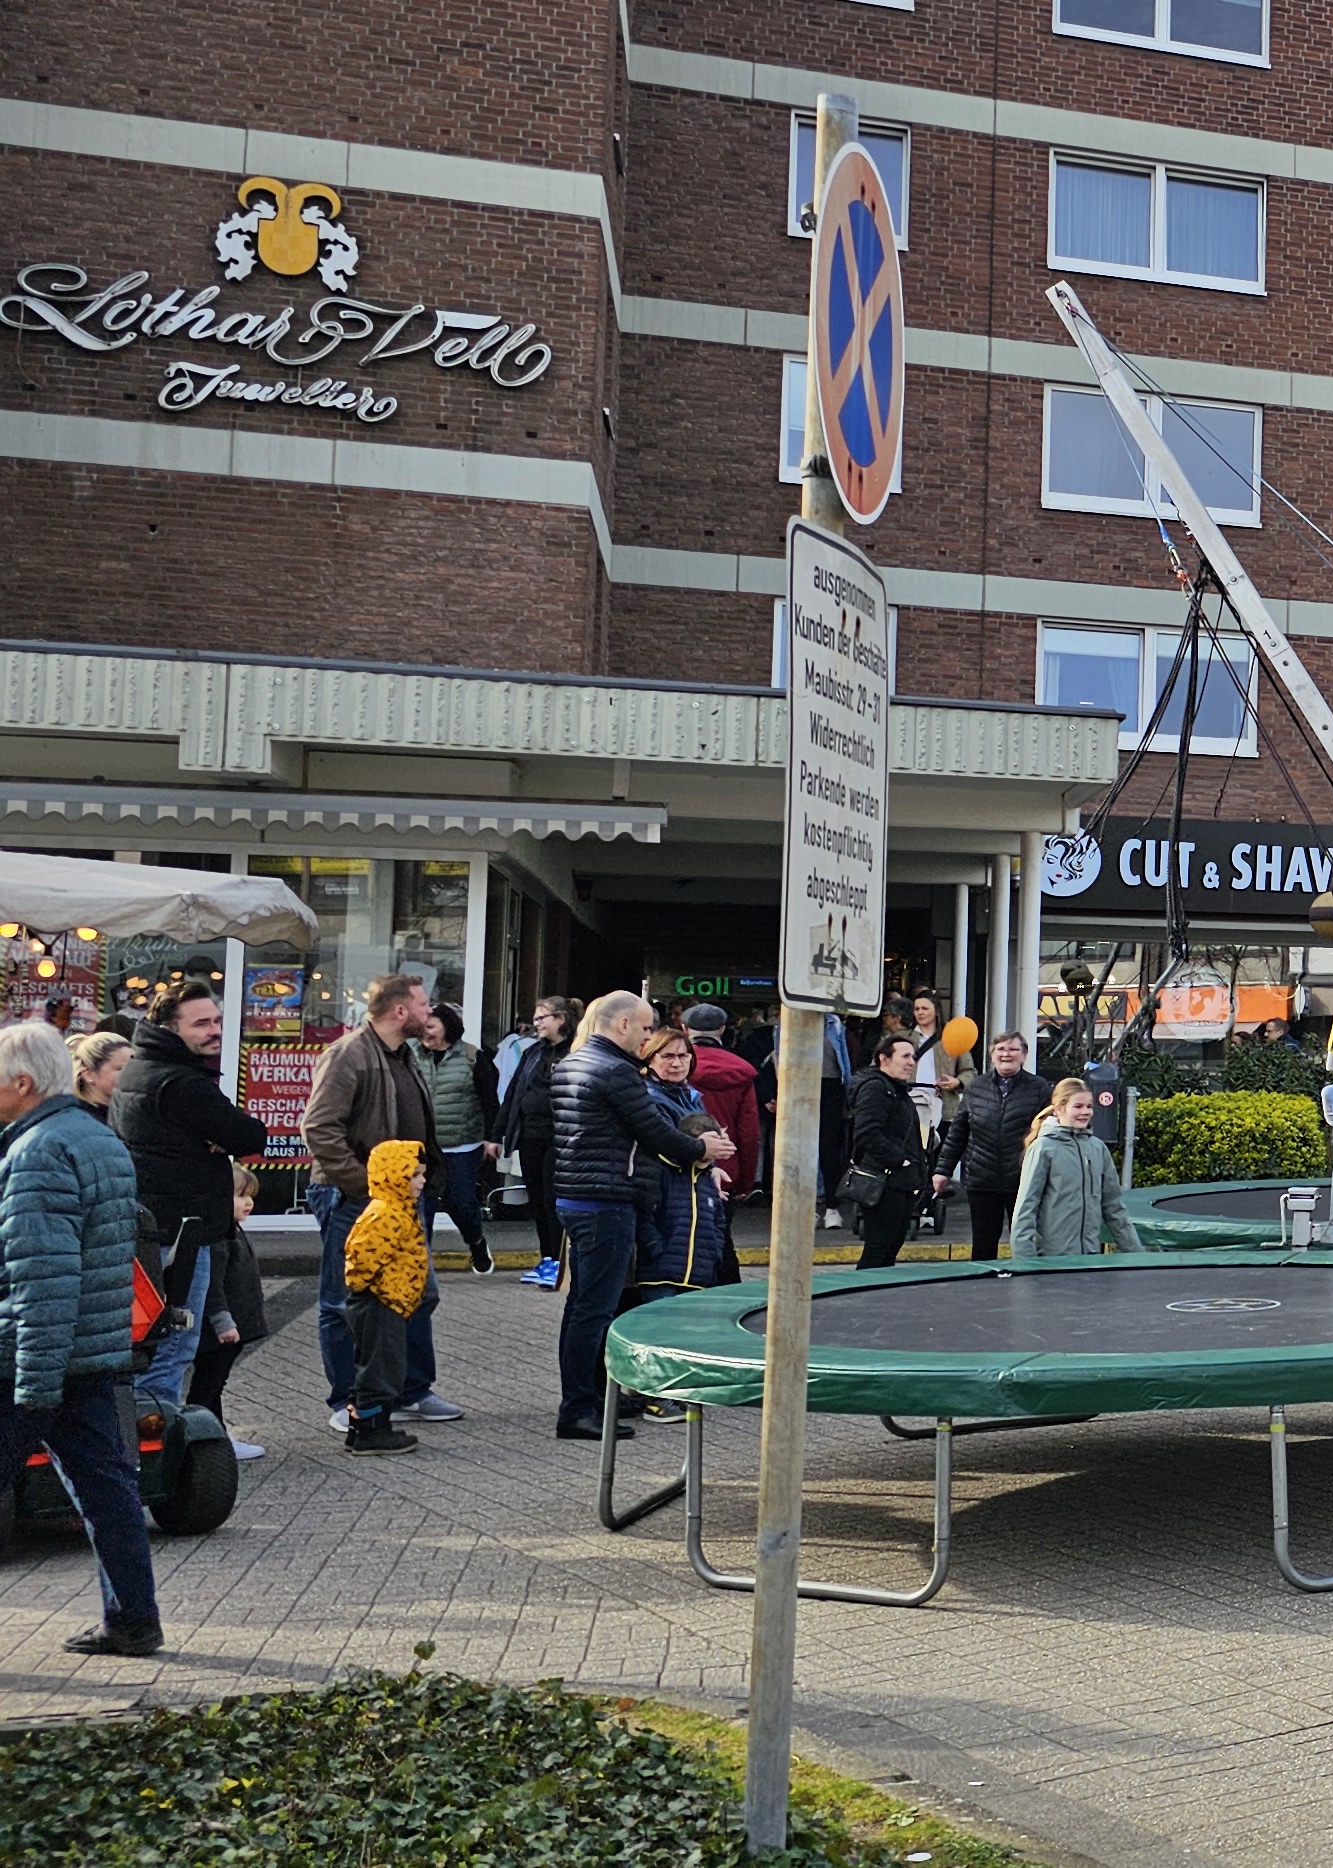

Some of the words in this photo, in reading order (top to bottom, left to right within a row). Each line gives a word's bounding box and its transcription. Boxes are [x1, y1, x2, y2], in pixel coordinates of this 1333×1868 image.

[0, 262, 335, 366] Lothar
[156, 360, 398, 423] Juwelier
[813, 565, 876, 622] ausgenommen
[795, 602, 835, 651] Kunden
[837, 630, 851, 660] der
[805, 658, 854, 712] Maubisstr.
[809, 710, 875, 770] Widerrechtlich
[800, 760, 846, 808] Parkende
[849, 786, 880, 821] werden
[803, 811, 874, 873] kostenpflichtig
[1119, 838, 1195, 888] CUT
[1203, 862, 1220, 890] &
[806, 866, 868, 919] abgeschleppt
[675, 976, 729, 996] Goll
[248, 1096, 306, 1111] GESCHÄ
